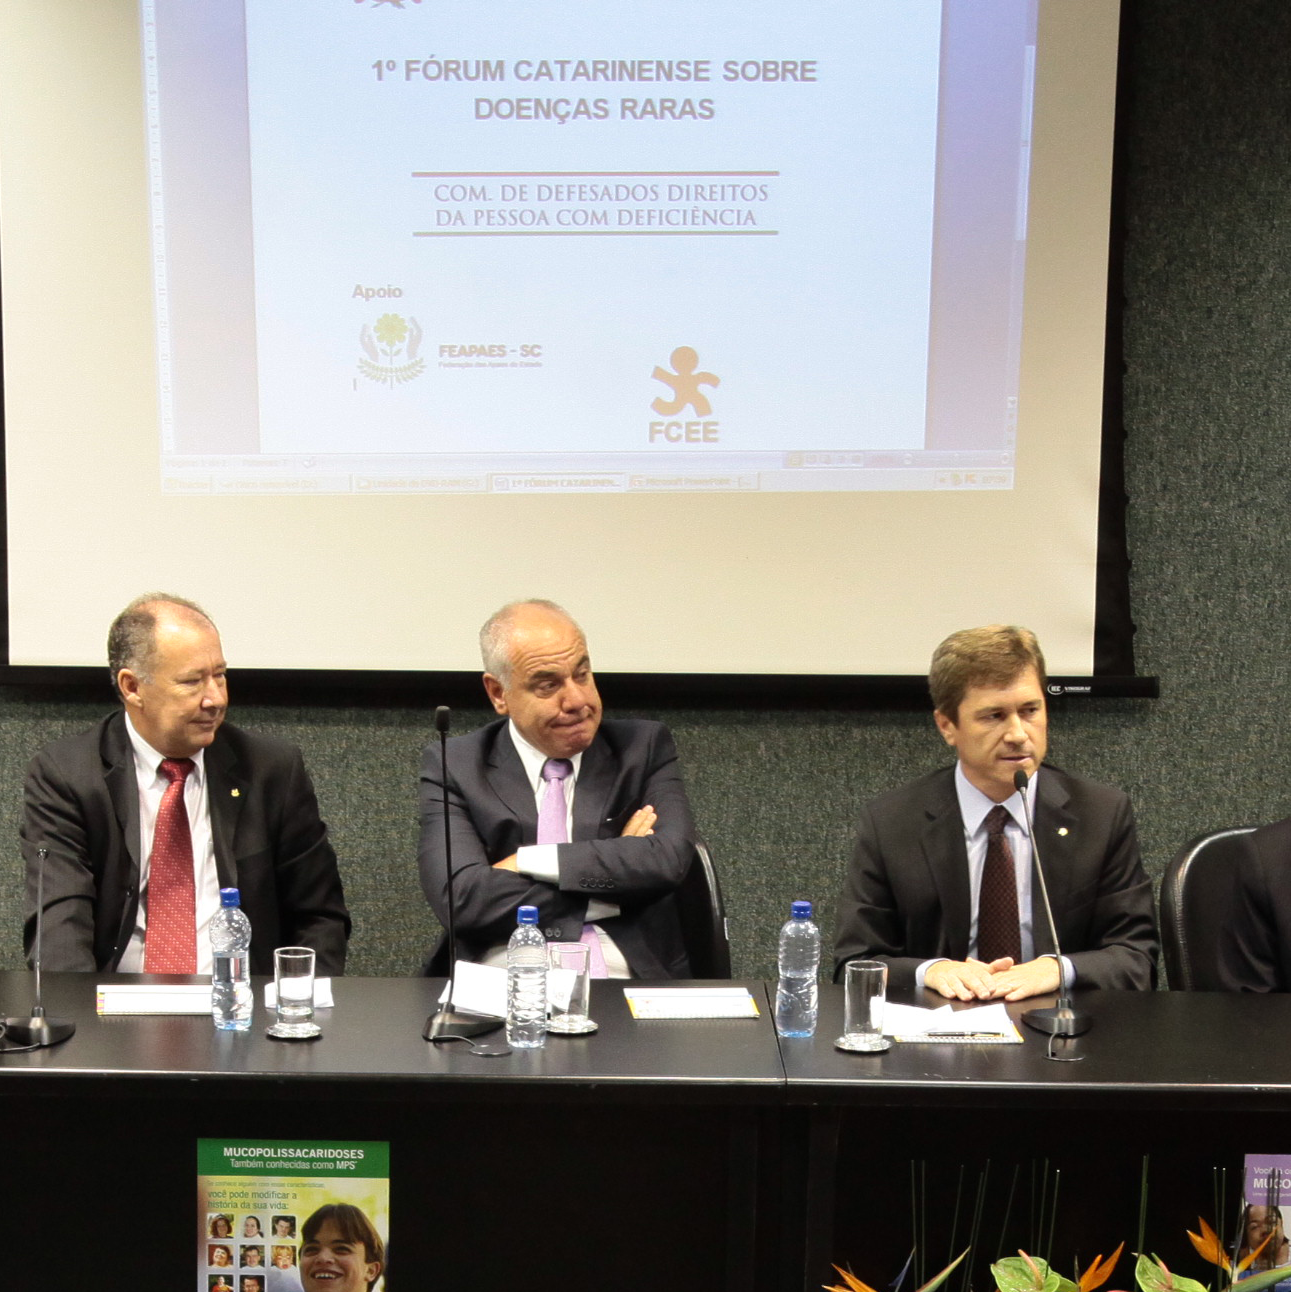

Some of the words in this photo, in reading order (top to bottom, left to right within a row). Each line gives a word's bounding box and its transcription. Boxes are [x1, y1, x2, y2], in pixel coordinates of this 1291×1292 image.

[371, 58, 398, 82] 1º
[404, 54, 506, 82] FÓRUM
[513, 59, 711, 82] CATARINENSE
[722, 59, 818, 82] SOBRE
[474, 97, 609, 124] DOENÇAS
[619, 98, 715, 120] RARAS
[433, 184, 493, 203] COM.
[500, 184, 529, 202] DE
[667, 184, 769, 203] DIREITOS
[435, 209, 466, 227] DA
[473, 208, 550, 227] PESSOA
[556, 208, 609, 227] COM
[616, 205, 757, 227] DEFICIÊNCIA
[352, 283, 403, 302] Apoio
[438, 344, 507, 358] FEAPAES
[519, 344, 543, 358] SC
[648, 421, 720, 443] FCEE
[223, 1147, 365, 1159] MUCOPOLISSACARIDOSES
[230, 1158, 264, 1169] Também
[265, 1159, 311, 1170] conhecidas
[312, 1161, 335, 1169] como
[208, 1189, 227, 1199] você
[229, 1190, 249, 1200] pode
[251, 1190, 289, 1200] modificar
[207, 1200, 238, 1209] história
[240, 1201, 251, 1209] da
[252, 1202, 268, 1210] sua
